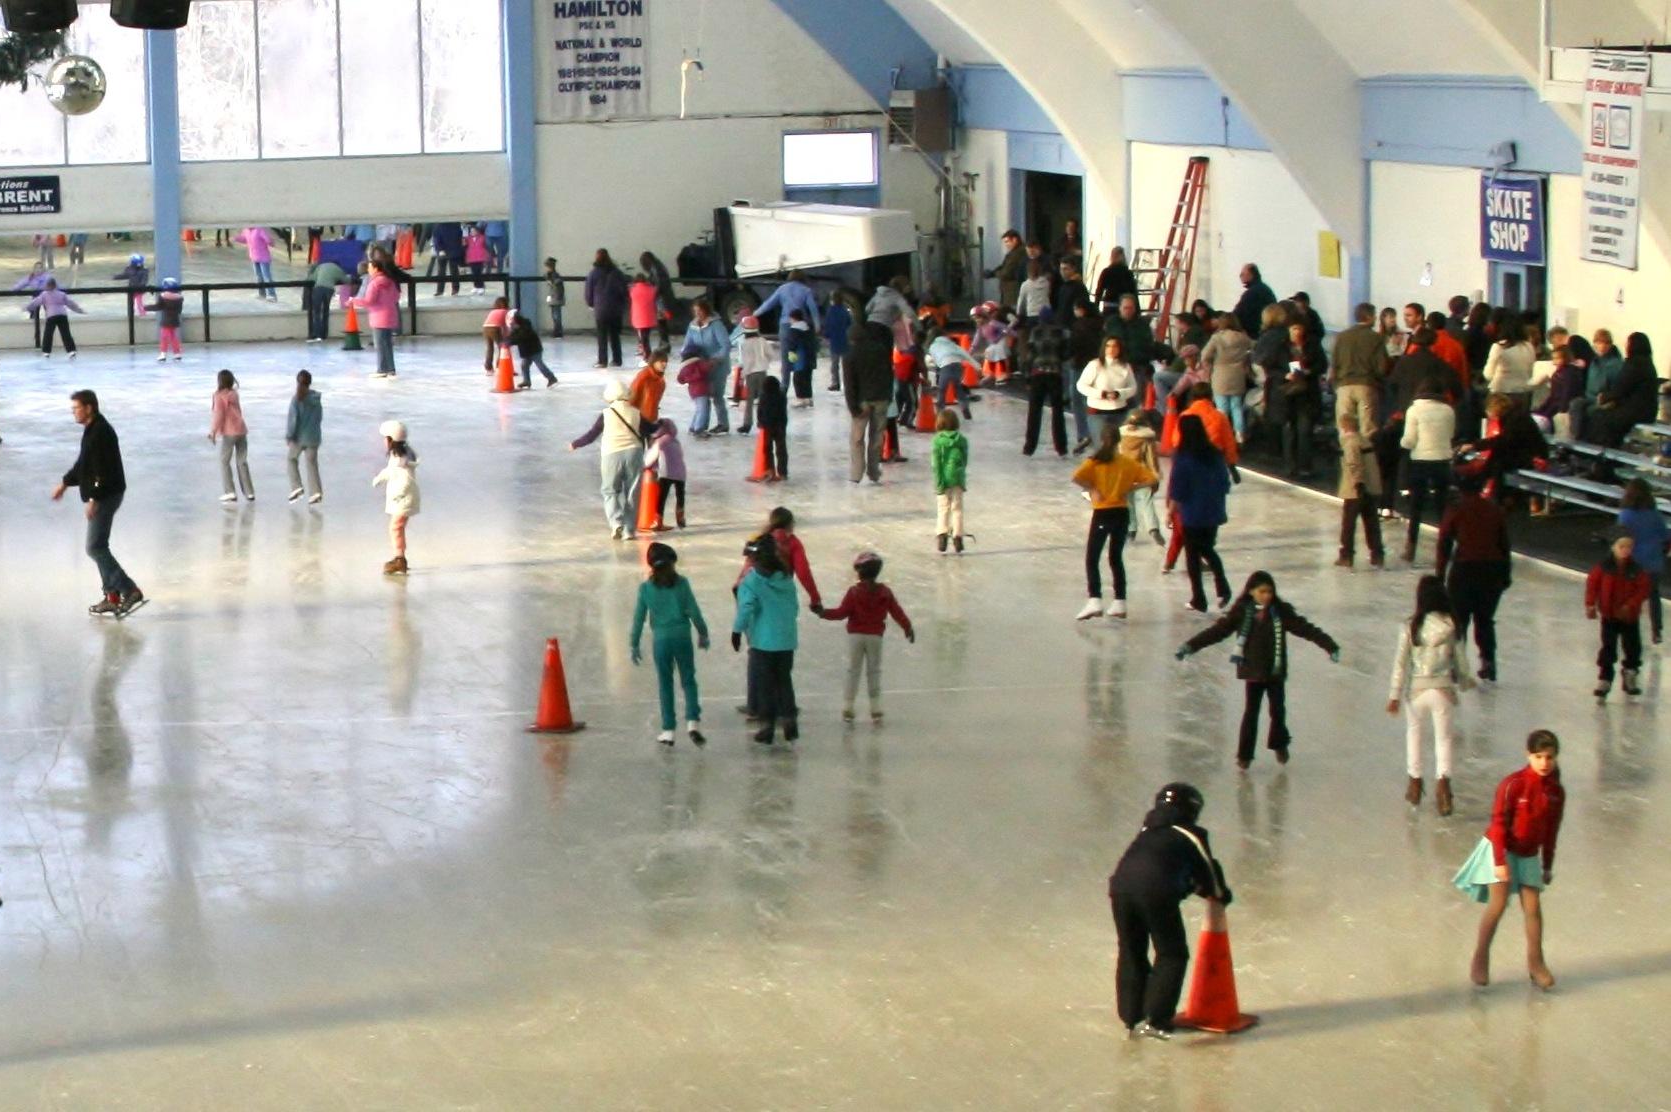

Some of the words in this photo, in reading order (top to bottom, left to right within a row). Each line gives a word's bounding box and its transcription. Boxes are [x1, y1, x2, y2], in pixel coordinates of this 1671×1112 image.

[554, 0, 642, 18] HAMILTON
[1486, 187, 1532, 220] SKATE
[1490, 221, 1529, 252] SHOP
